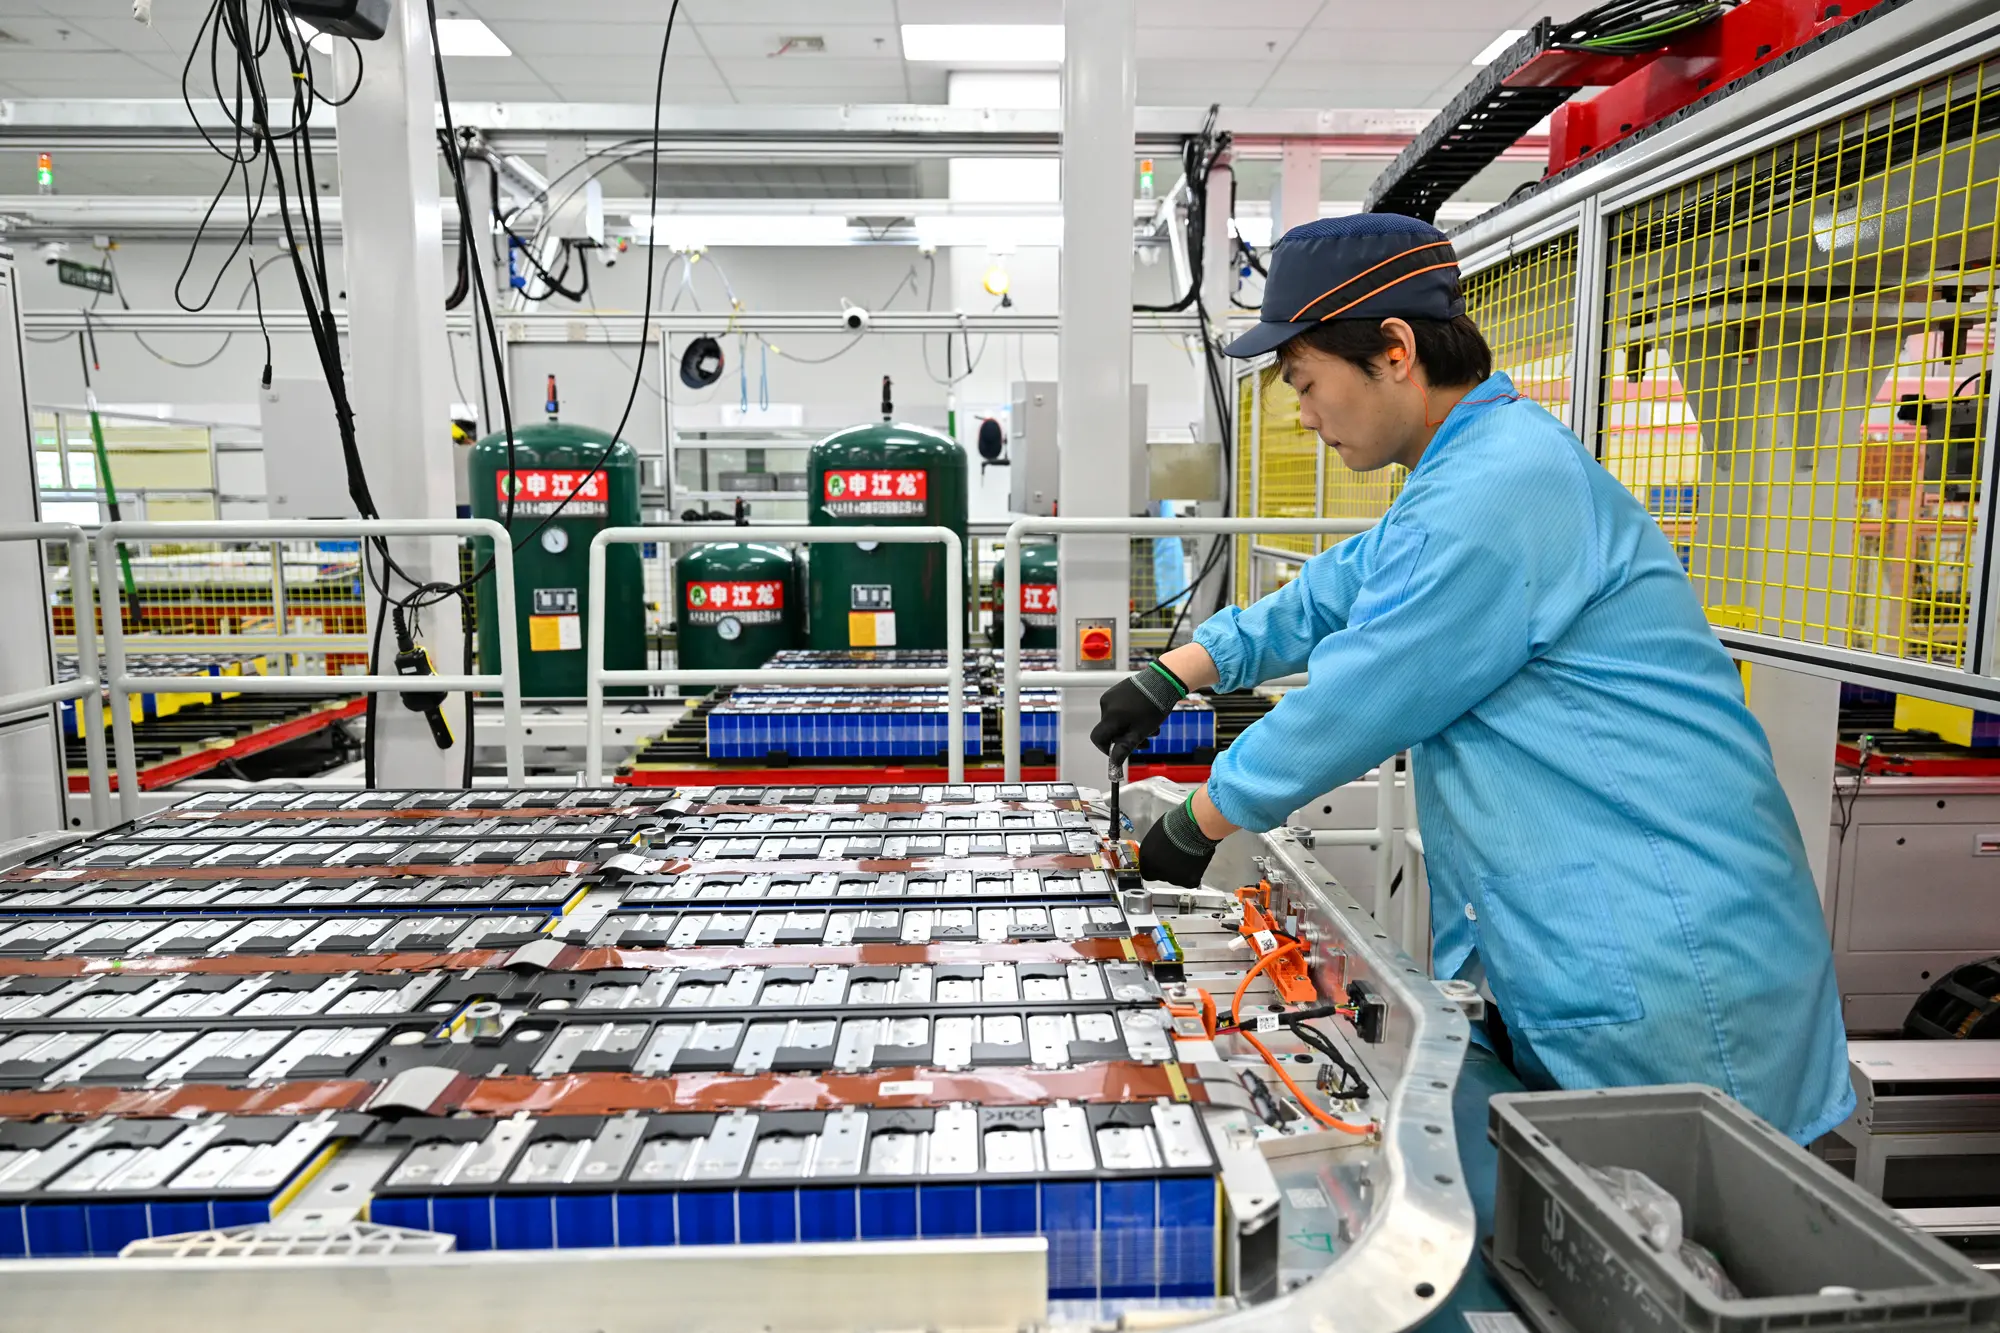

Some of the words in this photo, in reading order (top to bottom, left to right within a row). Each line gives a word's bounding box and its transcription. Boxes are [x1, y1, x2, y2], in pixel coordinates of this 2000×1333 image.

[848, 472, 917, 497] 申江龙
[709, 584, 776, 608] 申江龙
